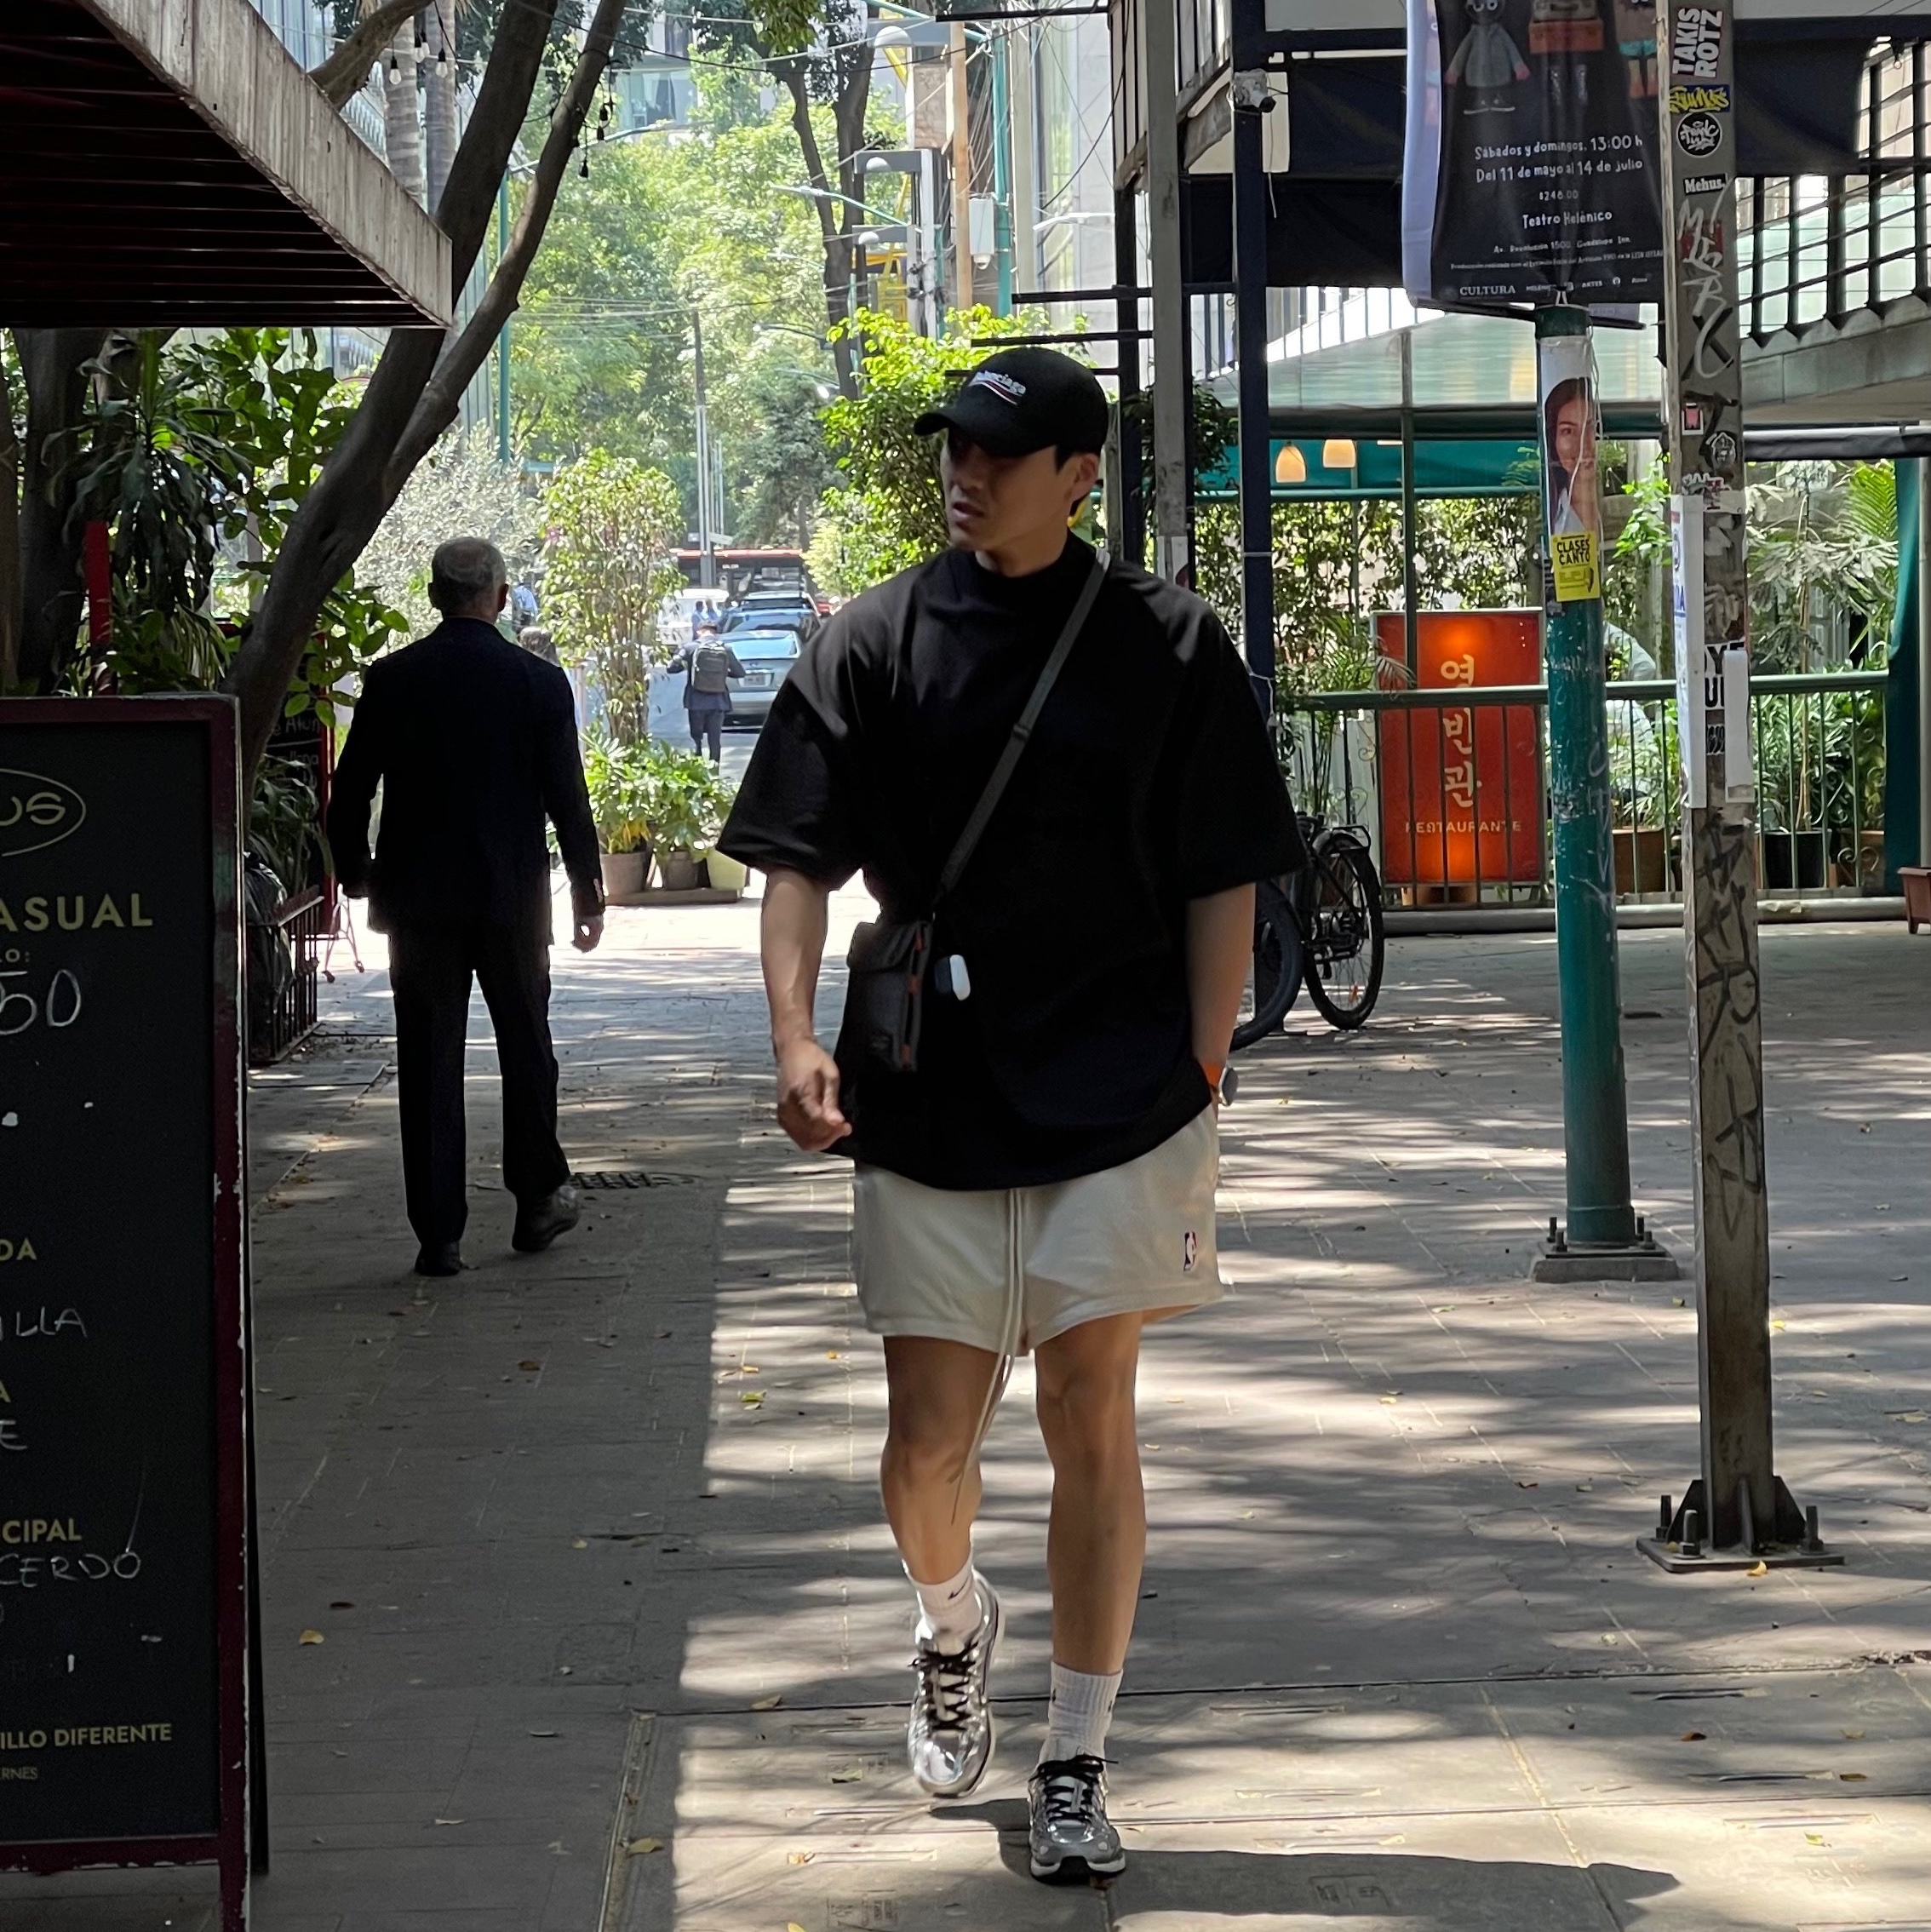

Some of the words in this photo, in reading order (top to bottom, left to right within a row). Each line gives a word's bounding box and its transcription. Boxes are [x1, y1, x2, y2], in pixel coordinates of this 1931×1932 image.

[1671, 8, 1701, 75] TAKIS
[1693, 9, 1723, 77] ROTZ
[1524, 146, 1532, 157] y
[1590, 135, 1632, 152] 13:00
[1635, 135, 1643, 146] h
[1476, 168, 1496, 183] Del
[1500, 167, 1513, 181] 11
[1517, 166, 1532, 178] de
[1533, 165, 1564, 177] mayo
[1566, 162, 1575, 175] al
[1577, 160, 1592, 175] 14
[1596, 160, 1612, 172] de
[1615, 158, 1643, 172] julio
[1522, 213, 1561, 229] Teatro
[1563, 210, 1613, 226] Helénico
[1459, 285, 1516, 296] CULTURA
[1556, 539, 1590, 554] CLASES
[1558, 550, 1590, 565] CANTO
[3, 1519, 83, 1544] CIPAL
[54, 1724, 173, 1748] DIFERENTE
